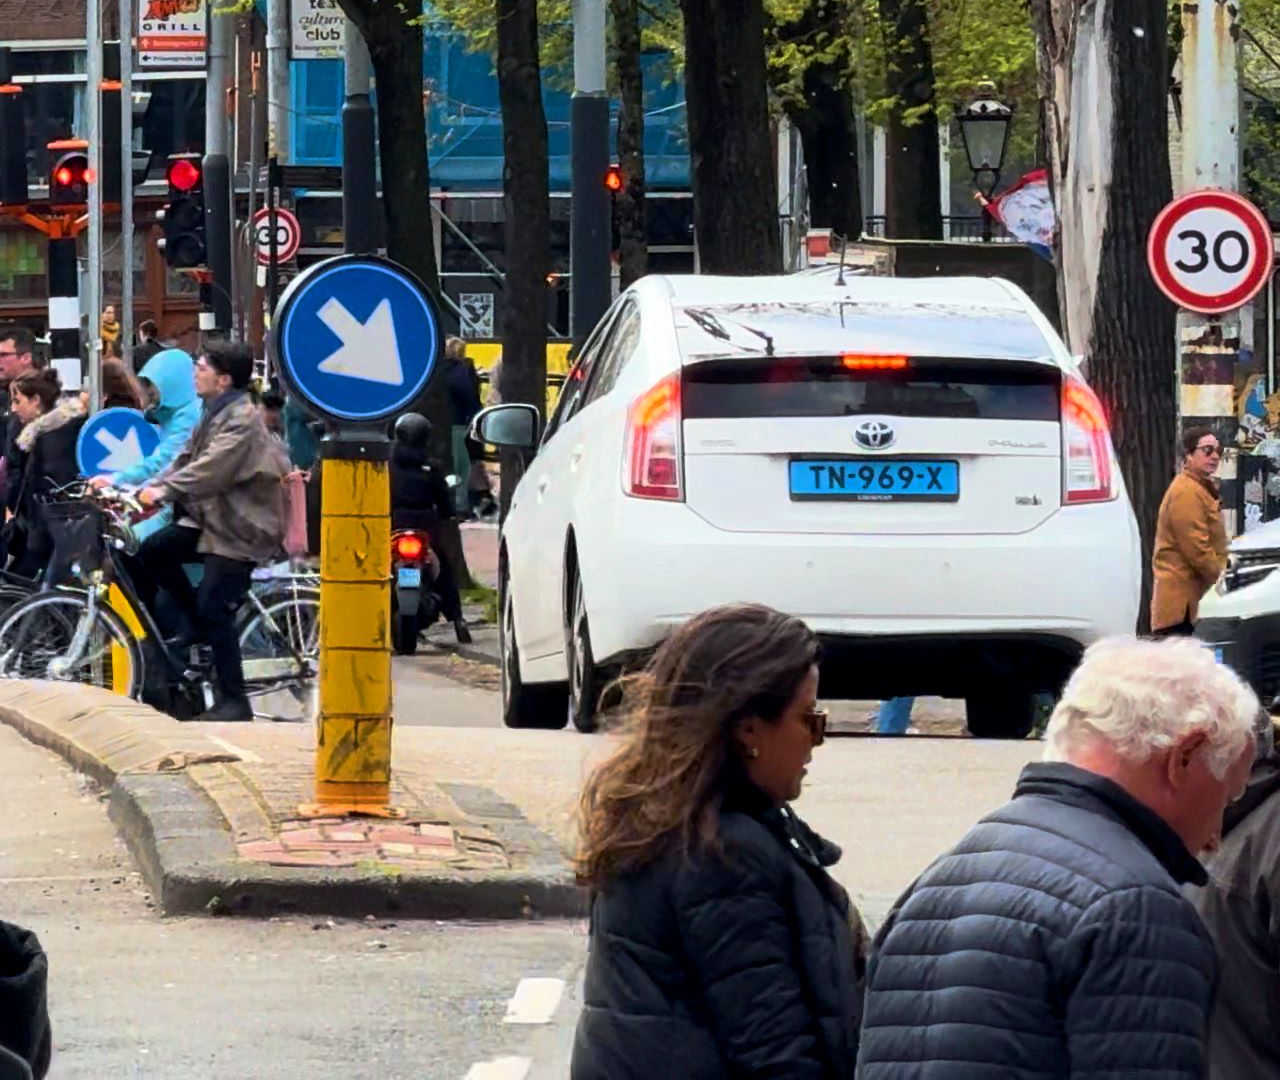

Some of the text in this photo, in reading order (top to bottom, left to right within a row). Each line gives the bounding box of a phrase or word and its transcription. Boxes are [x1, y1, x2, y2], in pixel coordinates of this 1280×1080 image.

[142, 23, 201, 31] GRILL
[305, 27, 340, 40] club
[256, 226, 289, 246] 30
[1174, 229, 1250, 273] 30
[809, 466, 943, 490] TN-969-X
